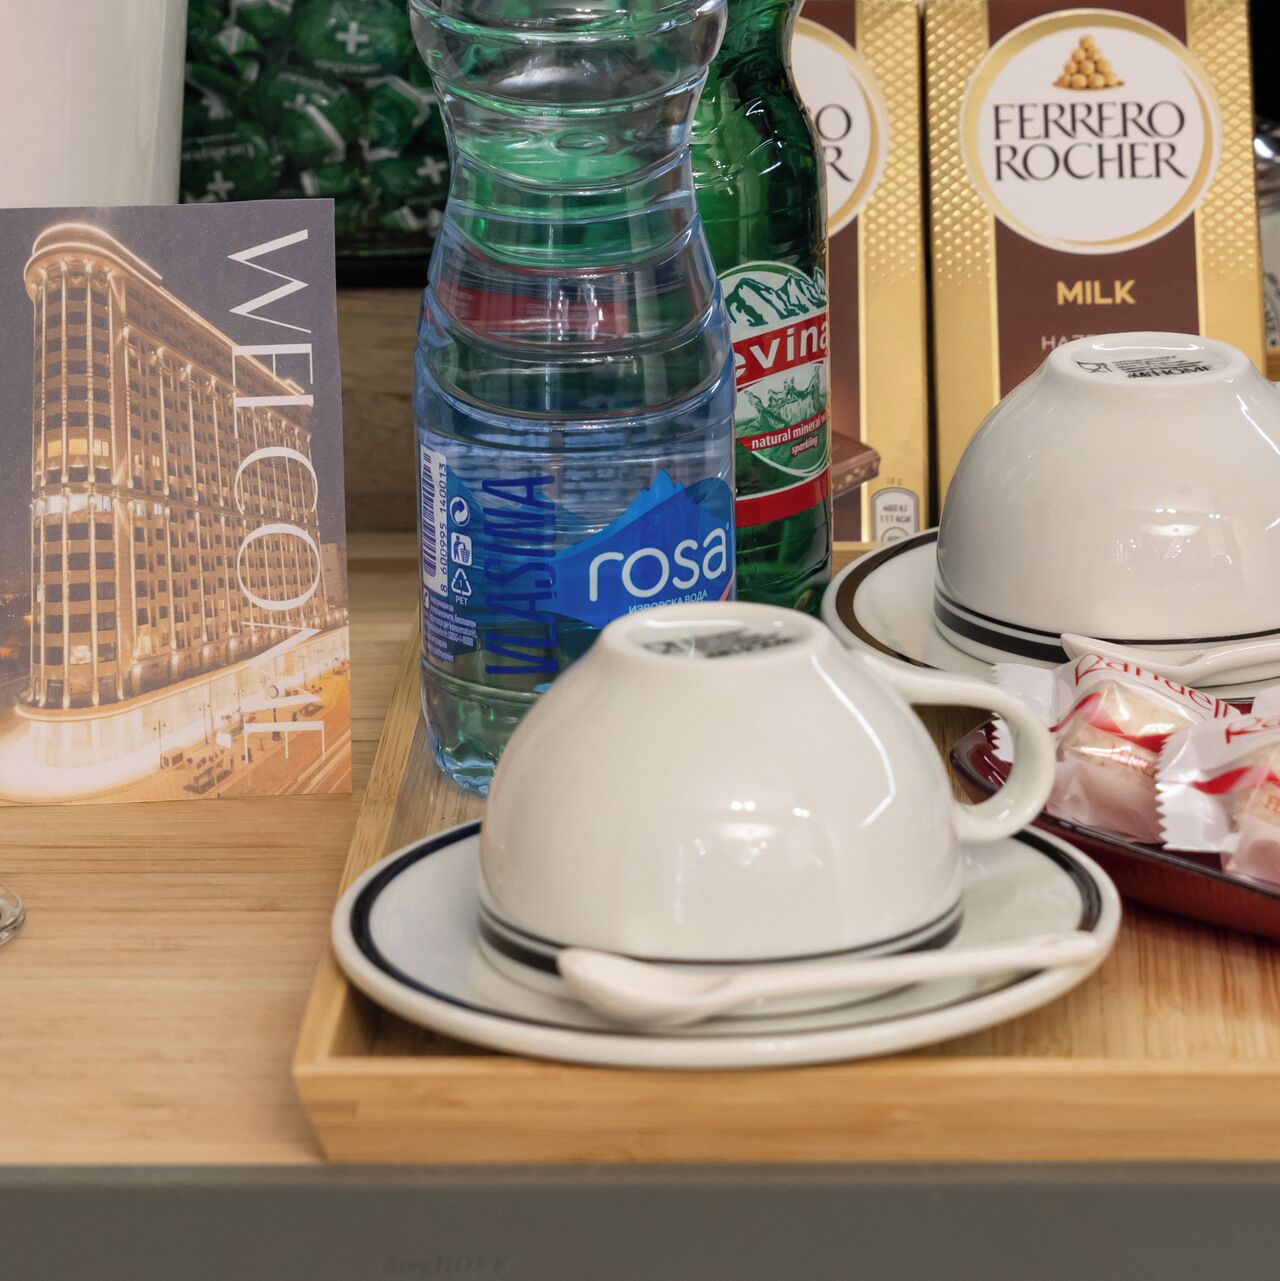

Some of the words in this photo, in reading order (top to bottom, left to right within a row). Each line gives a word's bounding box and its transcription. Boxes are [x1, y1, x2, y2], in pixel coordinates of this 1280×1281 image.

[993, 100, 1186, 141] FERRERO
[994, 142, 1188, 183] ROCHER
[1056, 279, 1137, 305] MILK
[751, 427, 792, 449] natural
[793, 419, 822, 437] mineral
[227, 229, 325, 762] WELCOME
[438, 463, 447, 513] 140013
[439, 523, 448, 576] 600995
[589, 527, 727, 602] rosa
[482, 475, 559, 675] VLASINA
[455, 595, 468, 606] PET
